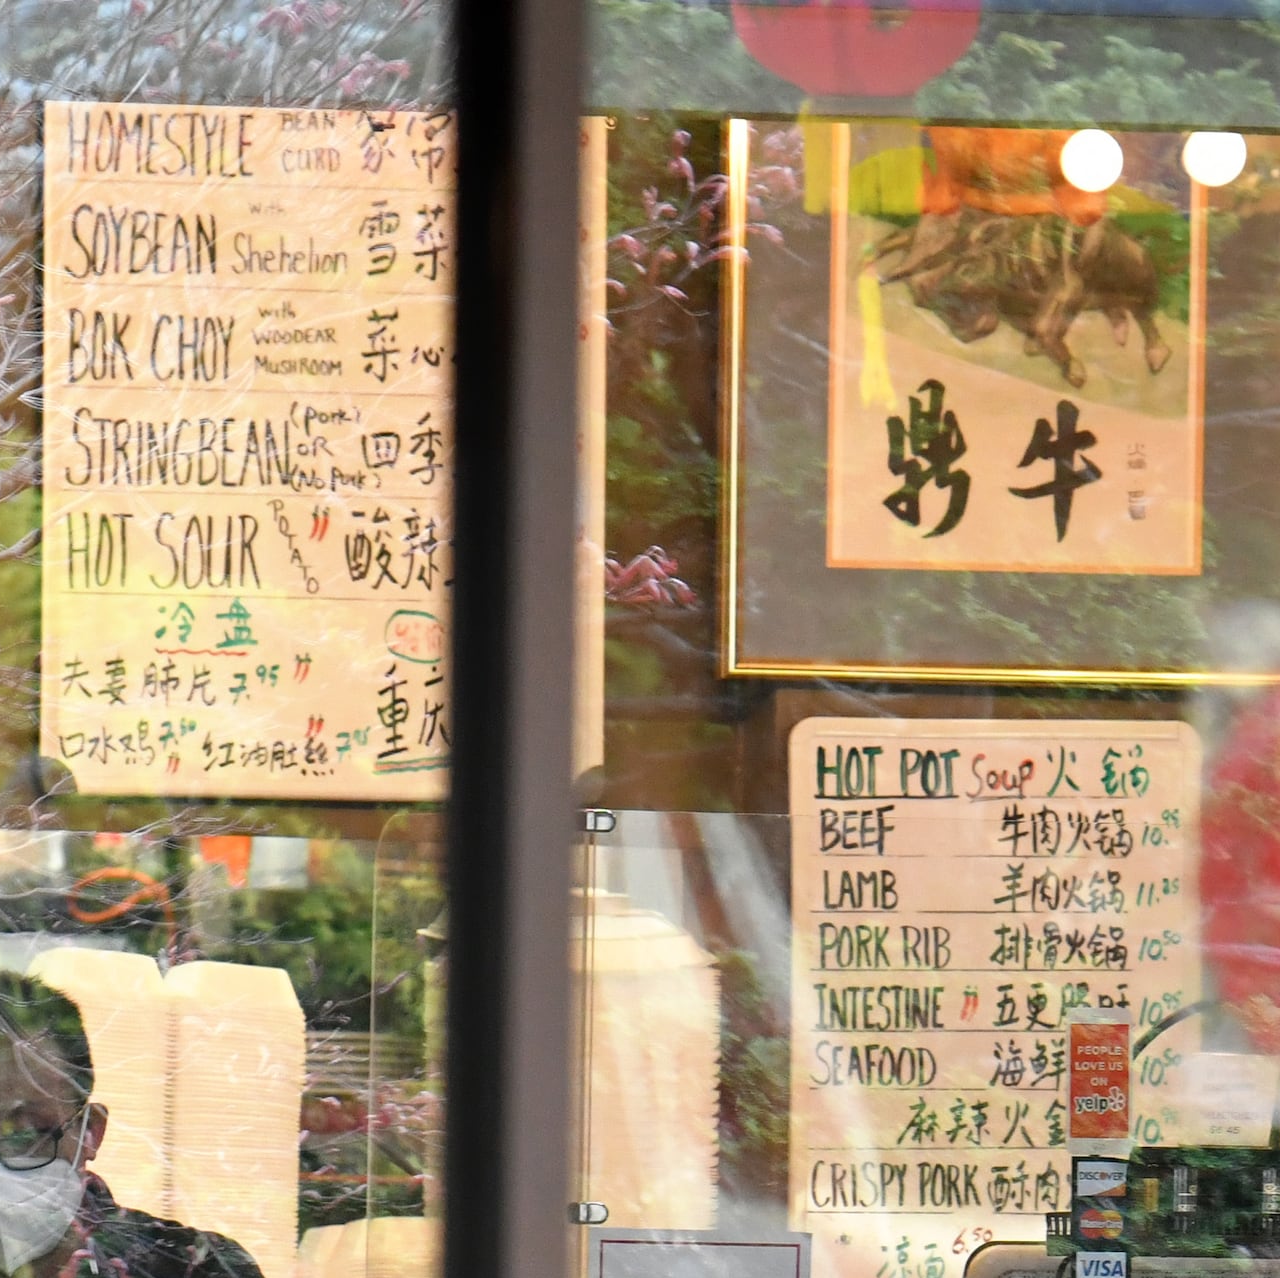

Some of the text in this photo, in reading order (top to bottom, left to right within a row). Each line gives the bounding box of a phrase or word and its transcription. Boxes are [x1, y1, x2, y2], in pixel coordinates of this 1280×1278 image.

[67, 111, 341, 178] HOMESTYLE BEAN CURD
[64, 202, 218, 279] SOYBEAN
[68, 301, 337, 383] BOK CHOY with WOODEAR
[64, 406, 291, 488] STRINGBEAN
[297, 437, 334, 459] OR
[66, 511, 134, 589] HOT
[149, 511, 261, 591] SOUR
[816, 743, 884, 796] HOT
[899, 747, 961, 797] POT
[965, 752, 1036, 799] Soup
[819, 804, 896, 856] BEEF
[822, 868, 900, 912] LAMB
[817, 921, 892, 971] PORK
[902, 925, 952, 970] RIB
[814, 981, 946, 1031] INTESTINE
[810, 1038, 938, 1089] SEAFOOD
[1074, 1060, 1124, 1072] LOVE US
[1077, 1045, 1123, 1057] PEOPLE
[1074, 1095, 1109, 1114] yelp
[810, 1158, 982, 1210] CRISPY PORK
[1078, 1170, 1126, 1182] DISCOVER
[1080, 1258, 1125, 1278] VISA
